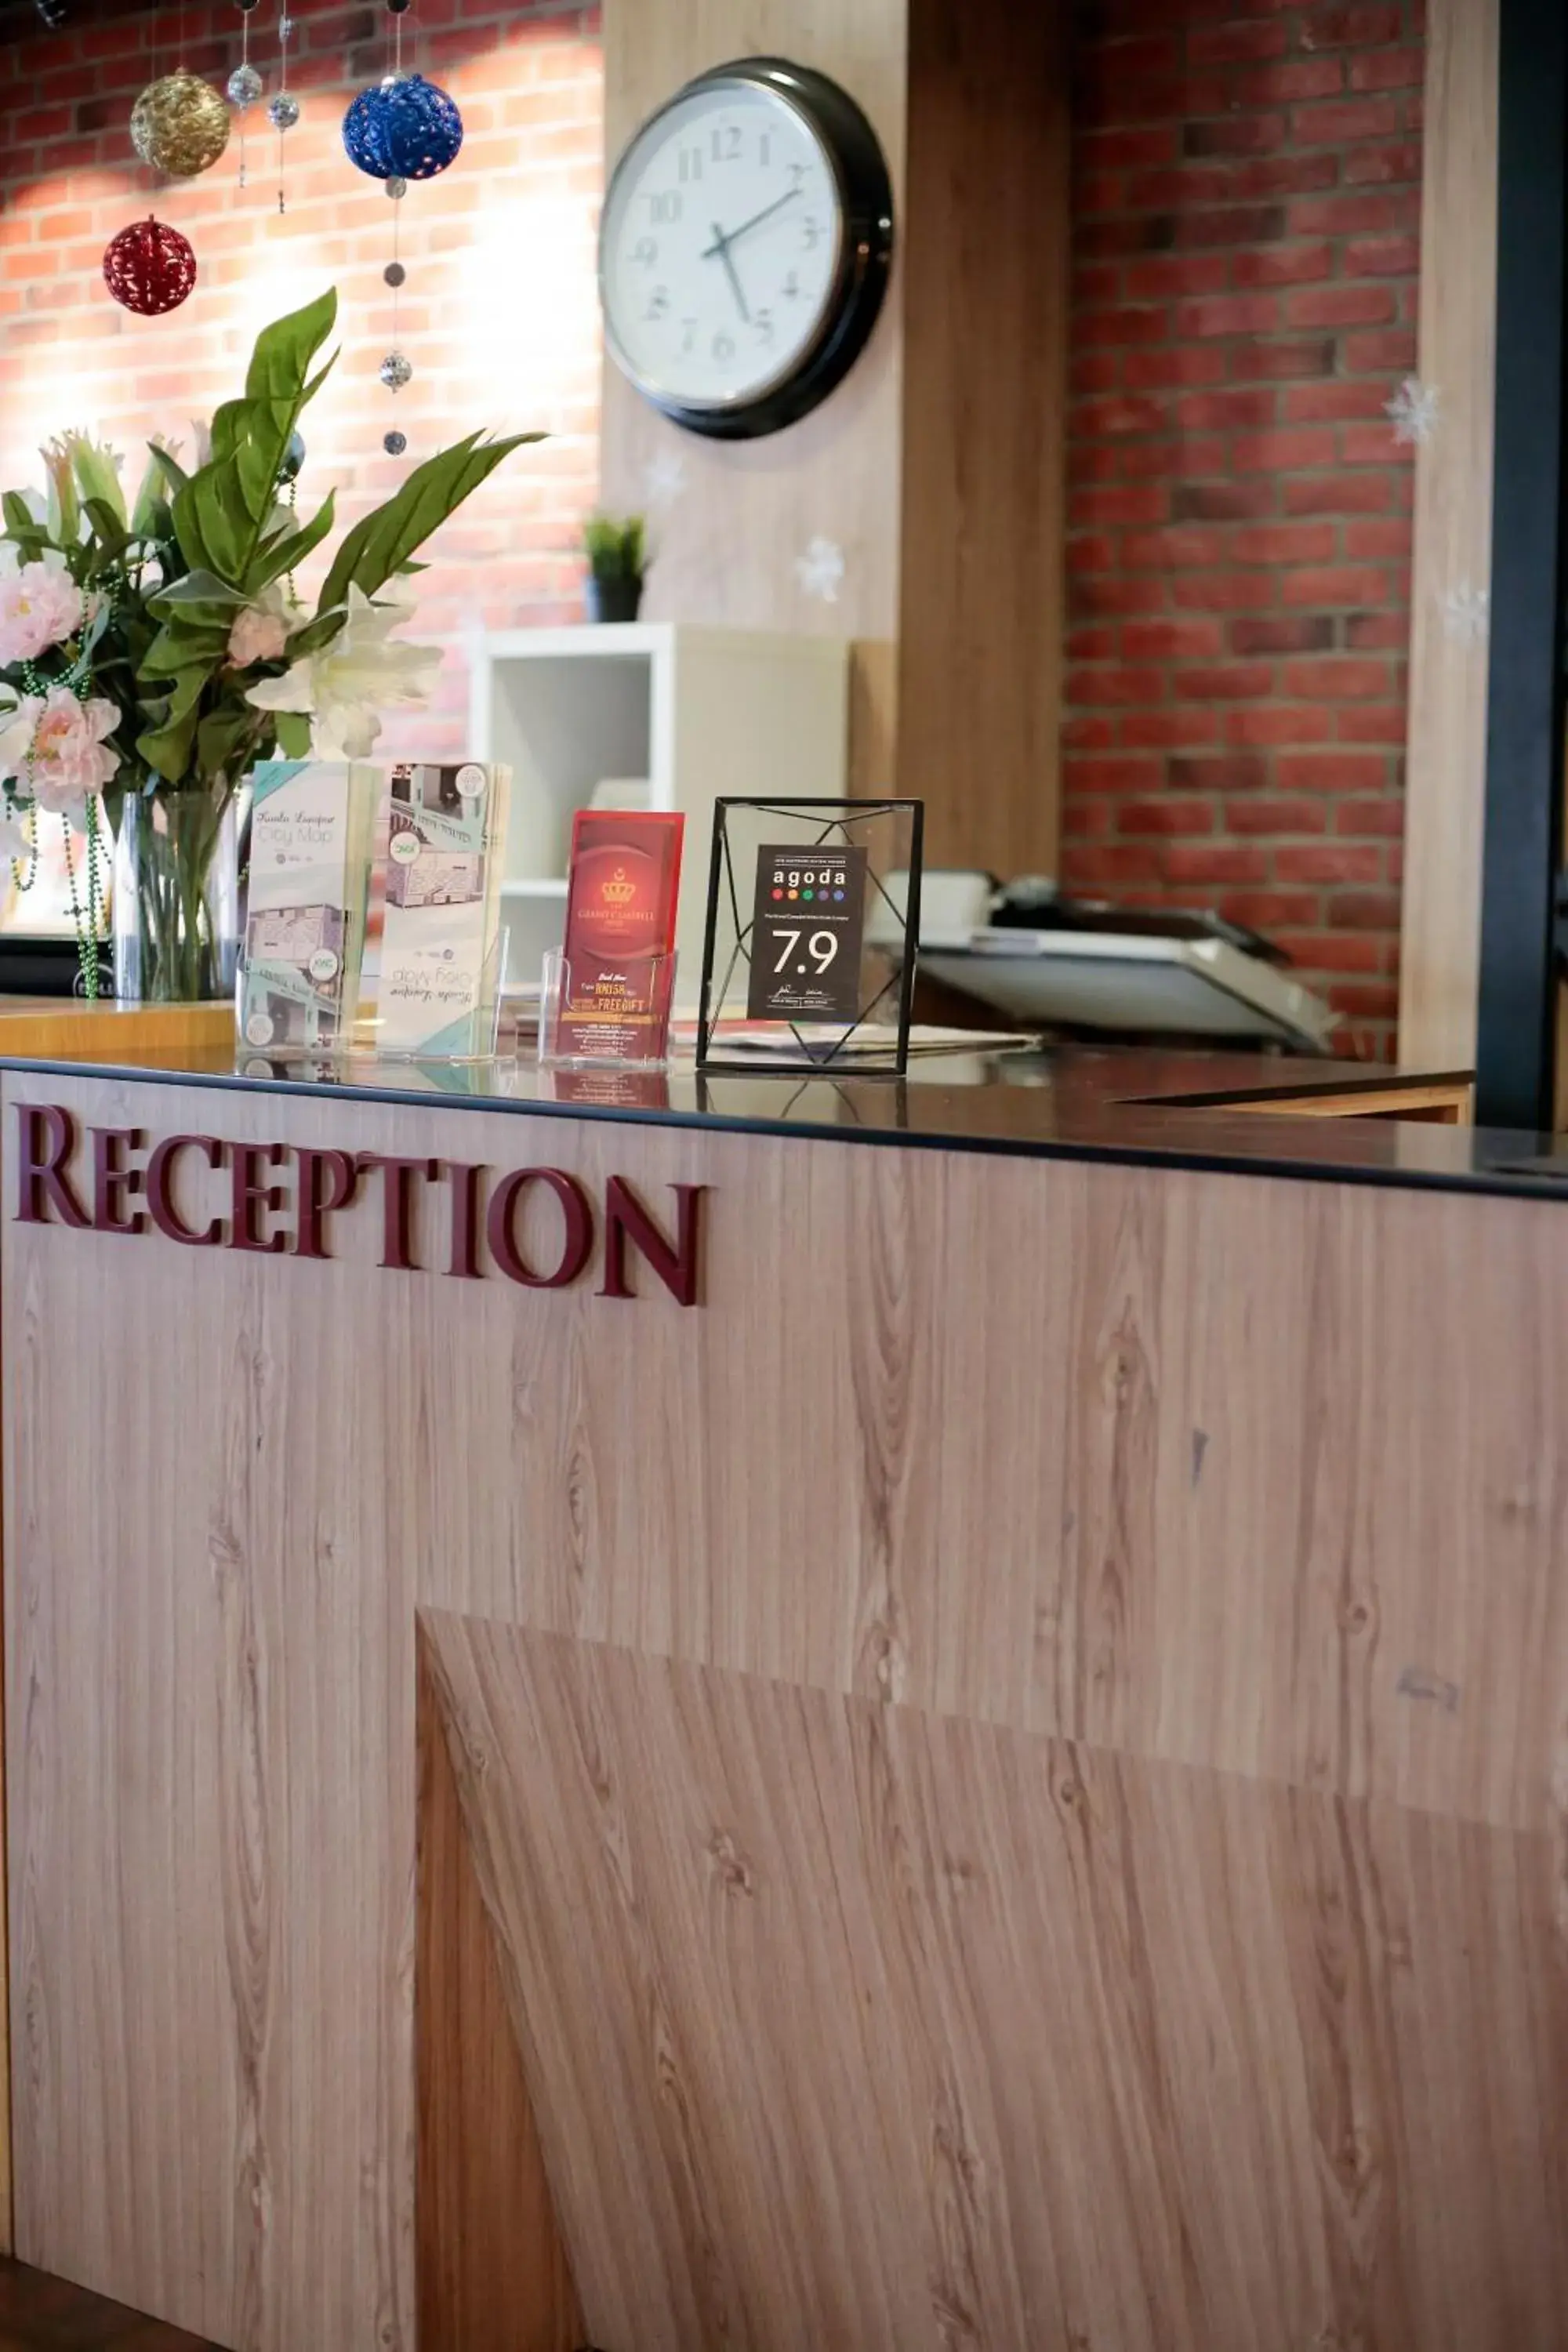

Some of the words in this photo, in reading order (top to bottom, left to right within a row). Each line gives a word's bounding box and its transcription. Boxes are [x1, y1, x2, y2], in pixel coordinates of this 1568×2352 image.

[711, 126, 742, 162] 12
[758, 131, 771, 166] 1
[677, 146, 702, 183] 11
[649, 189, 684, 225] 10
[711, 332, 736, 361] 6
[256, 810, 290, 824] Kuala
[773, 868, 845, 887] agoda
[772, 930, 838, 975] 7.9
[13, 1103, 709, 1307] RECEPTION
